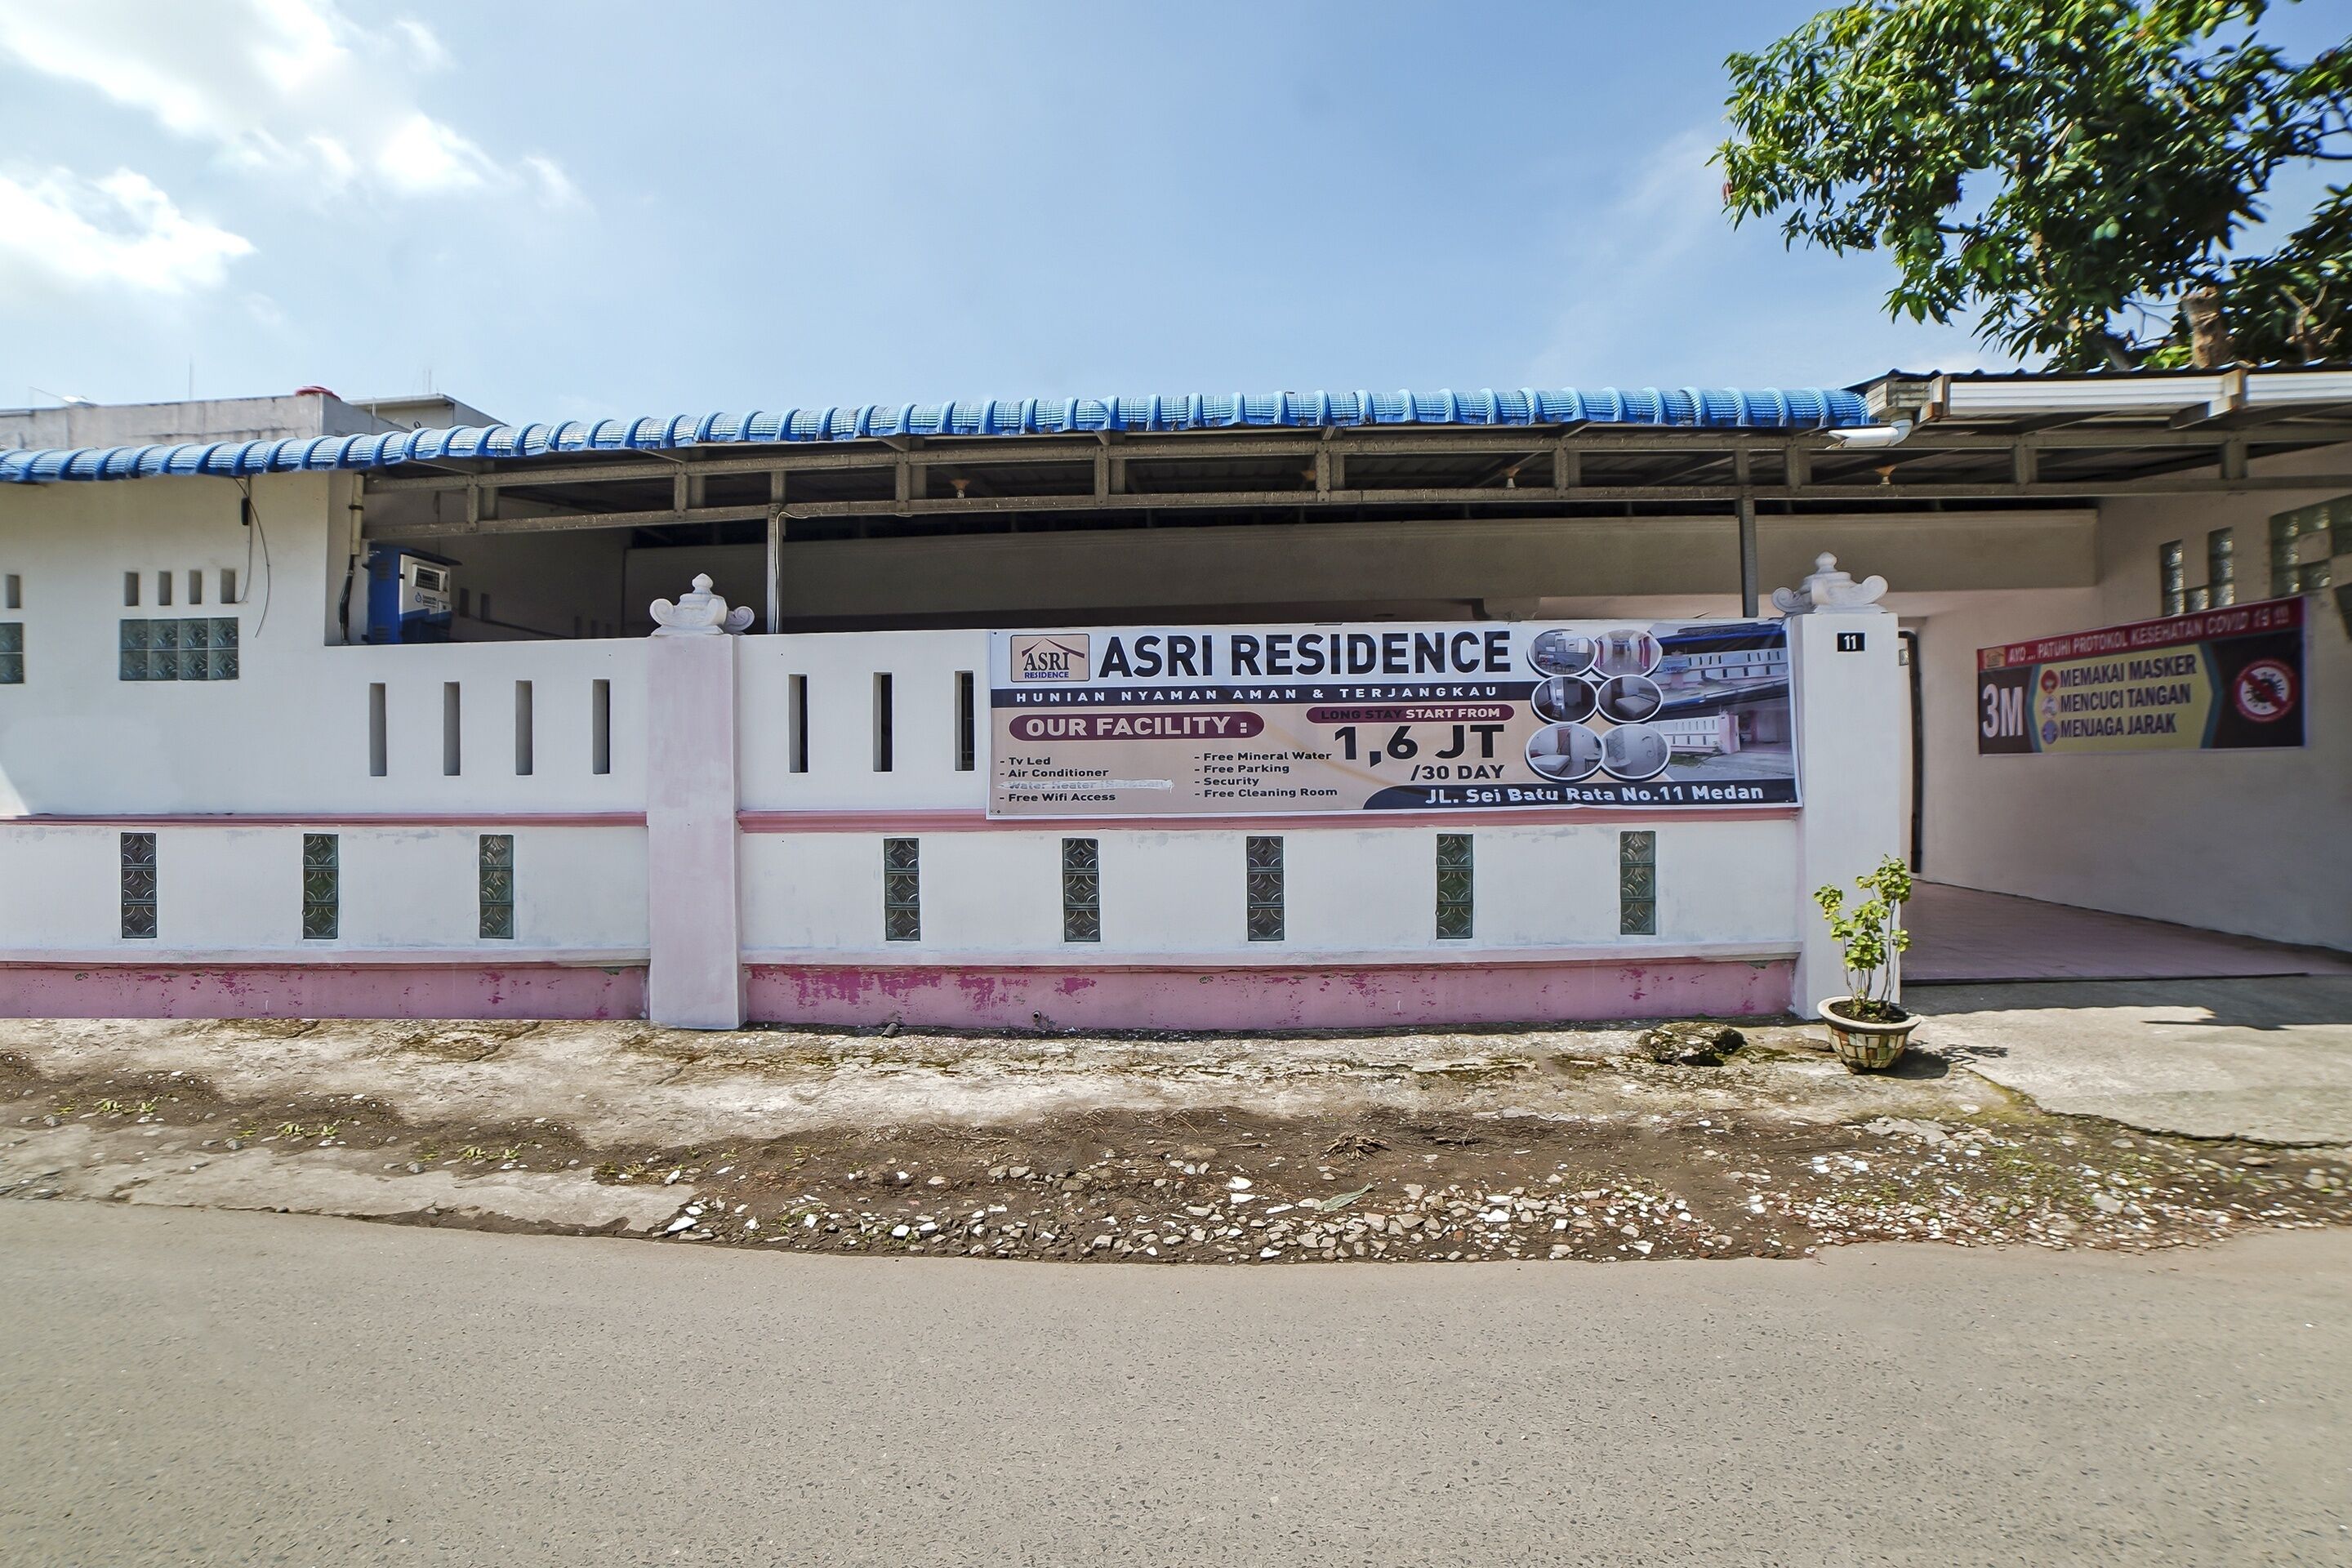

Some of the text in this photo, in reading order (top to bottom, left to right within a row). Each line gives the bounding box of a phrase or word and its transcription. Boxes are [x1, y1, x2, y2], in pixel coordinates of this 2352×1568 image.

[1843, 635, 1857, 650] 11
[2038, 640, 2070, 658] PATUHI
[2073, 632, 2127, 653] PROTOKOL
[2131, 617, 2203, 646] KESEHATAN
[2207, 611, 2249, 635] COVID
[1023, 652, 1070, 671] ASRI
[1098, 630, 1511, 678] ASRI RESIDENCE
[2060, 653, 2197, 688] MEMAKAI MASKER
[1015, 686, 1497, 703] HUNIAN NYAMAN AMAN & TERJANGKAU
[2060, 683, 2190, 713] MENCUCI TANGAN
[1321, 706, 1500, 719] LONG STAY START FROM
[1982, 683, 2024, 738] 3M
[1026, 717, 1087, 737] OUR
[1096, 715, 1231, 736] FACILITY
[2060, 713, 2176, 738] MENJAGA JARAK
[1334, 724, 1505, 768] 1,6 JT
[1009, 757, 1051, 765] Tv Led
[1203, 751, 1332, 761] Free Mineral Water
[1008, 768, 1109, 777] Air Conditioner
[1203, 764, 1290, 775] Free Parking
[1410, 764, 1506, 782] /30 DAY
[1204, 777, 1260, 787] Security
[1009, 793, 1116, 802] Free Wifi Access
[1204, 787, 1338, 800] Free Cleaning Room
[1425, 784, 1764, 805] JL. Sei Batu Rata No.11 Medan
